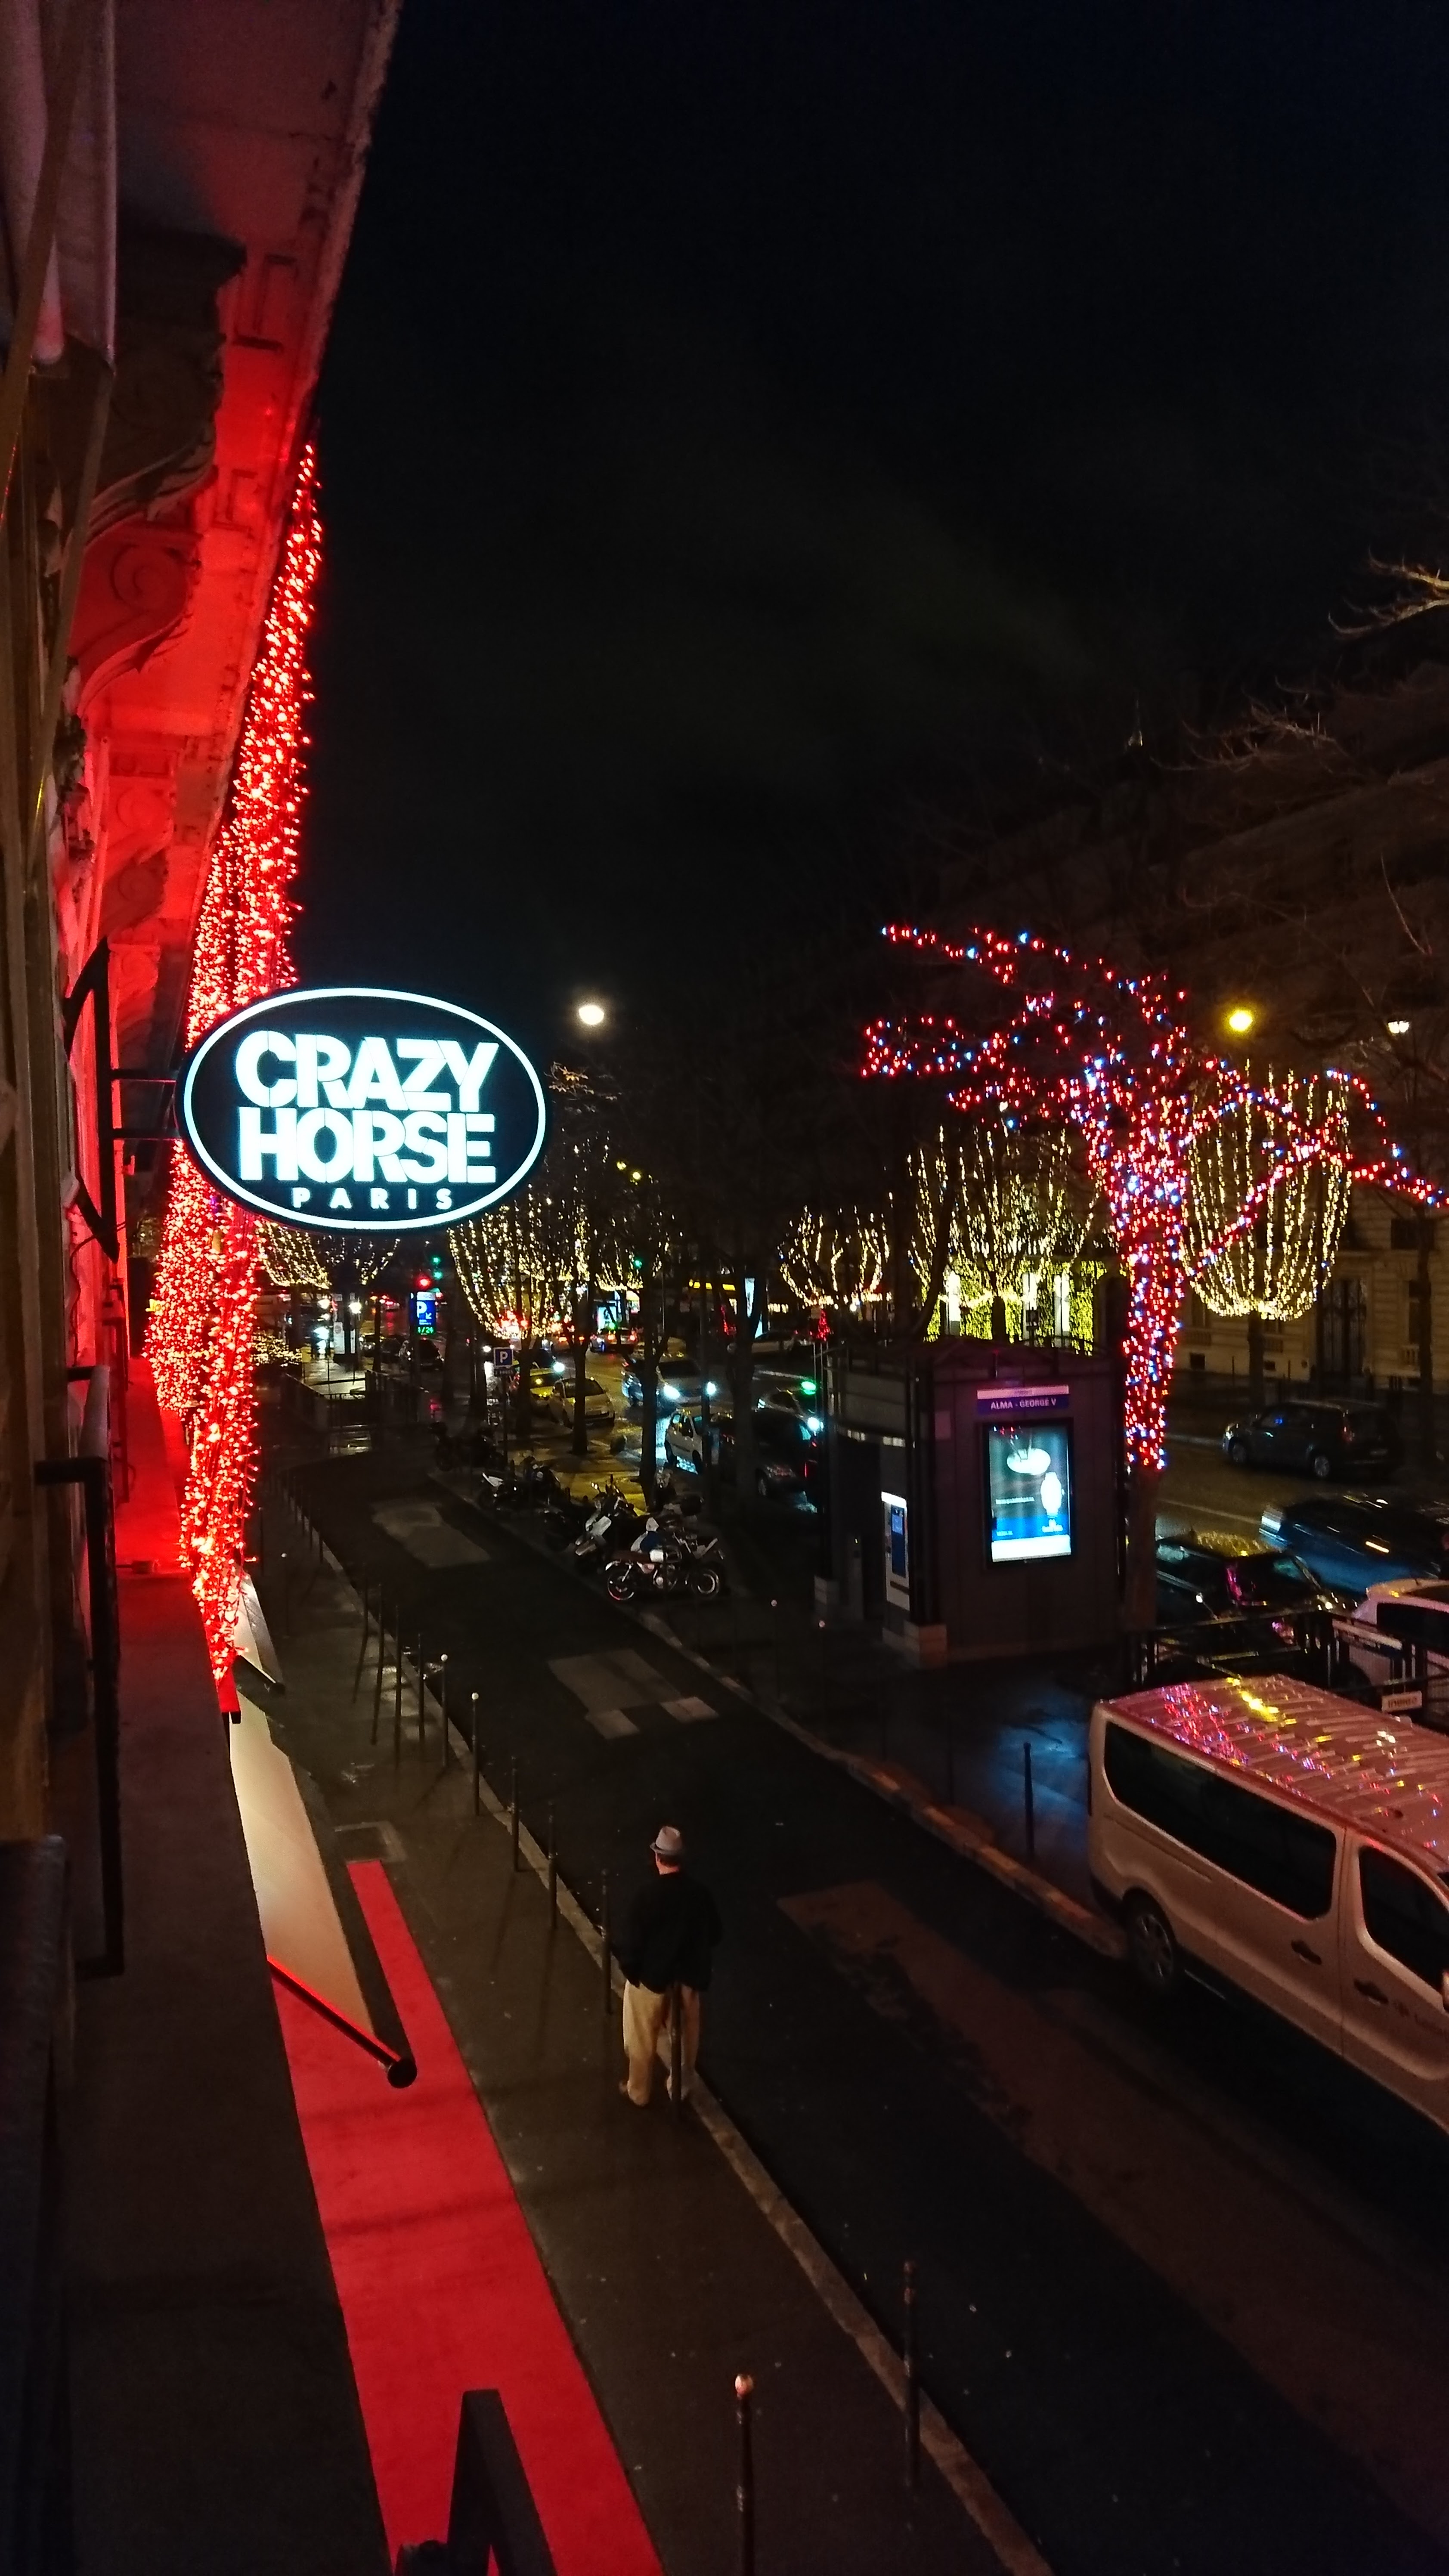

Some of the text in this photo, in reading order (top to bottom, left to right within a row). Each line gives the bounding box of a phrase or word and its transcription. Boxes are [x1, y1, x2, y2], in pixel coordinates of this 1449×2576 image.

[235, 1031, 499, 1112] CRAZY
[238, 1106, 496, 1184] HORSE
[294, 1187, 452, 1209] PARIS
[417, 1301, 427, 1318] P
[500, 1351, 508, 1363] P
[991, 1401, 1013, 1410] ALMA
[1019, 1399, 1049, 1408] GEORGE
[1051, 1398, 1056, 1406] V
